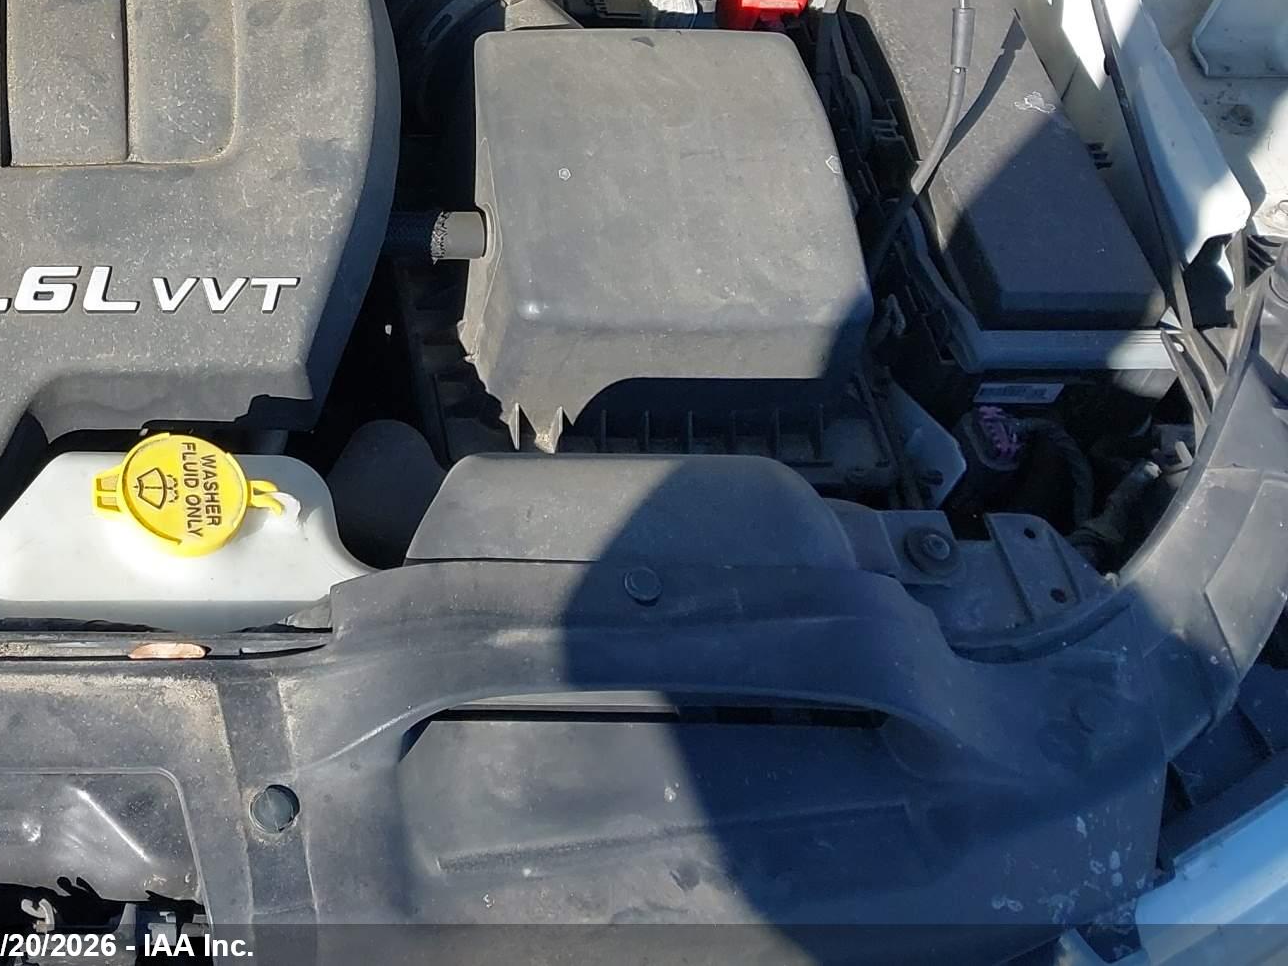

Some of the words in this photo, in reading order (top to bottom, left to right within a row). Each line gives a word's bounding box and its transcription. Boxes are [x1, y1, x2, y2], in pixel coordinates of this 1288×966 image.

[152, 276, 301, 314] VVT
[181, 442, 200, 489] FLUID
[200, 454, 222, 526] WASHER
[185, 494, 204, 537] ONLY
